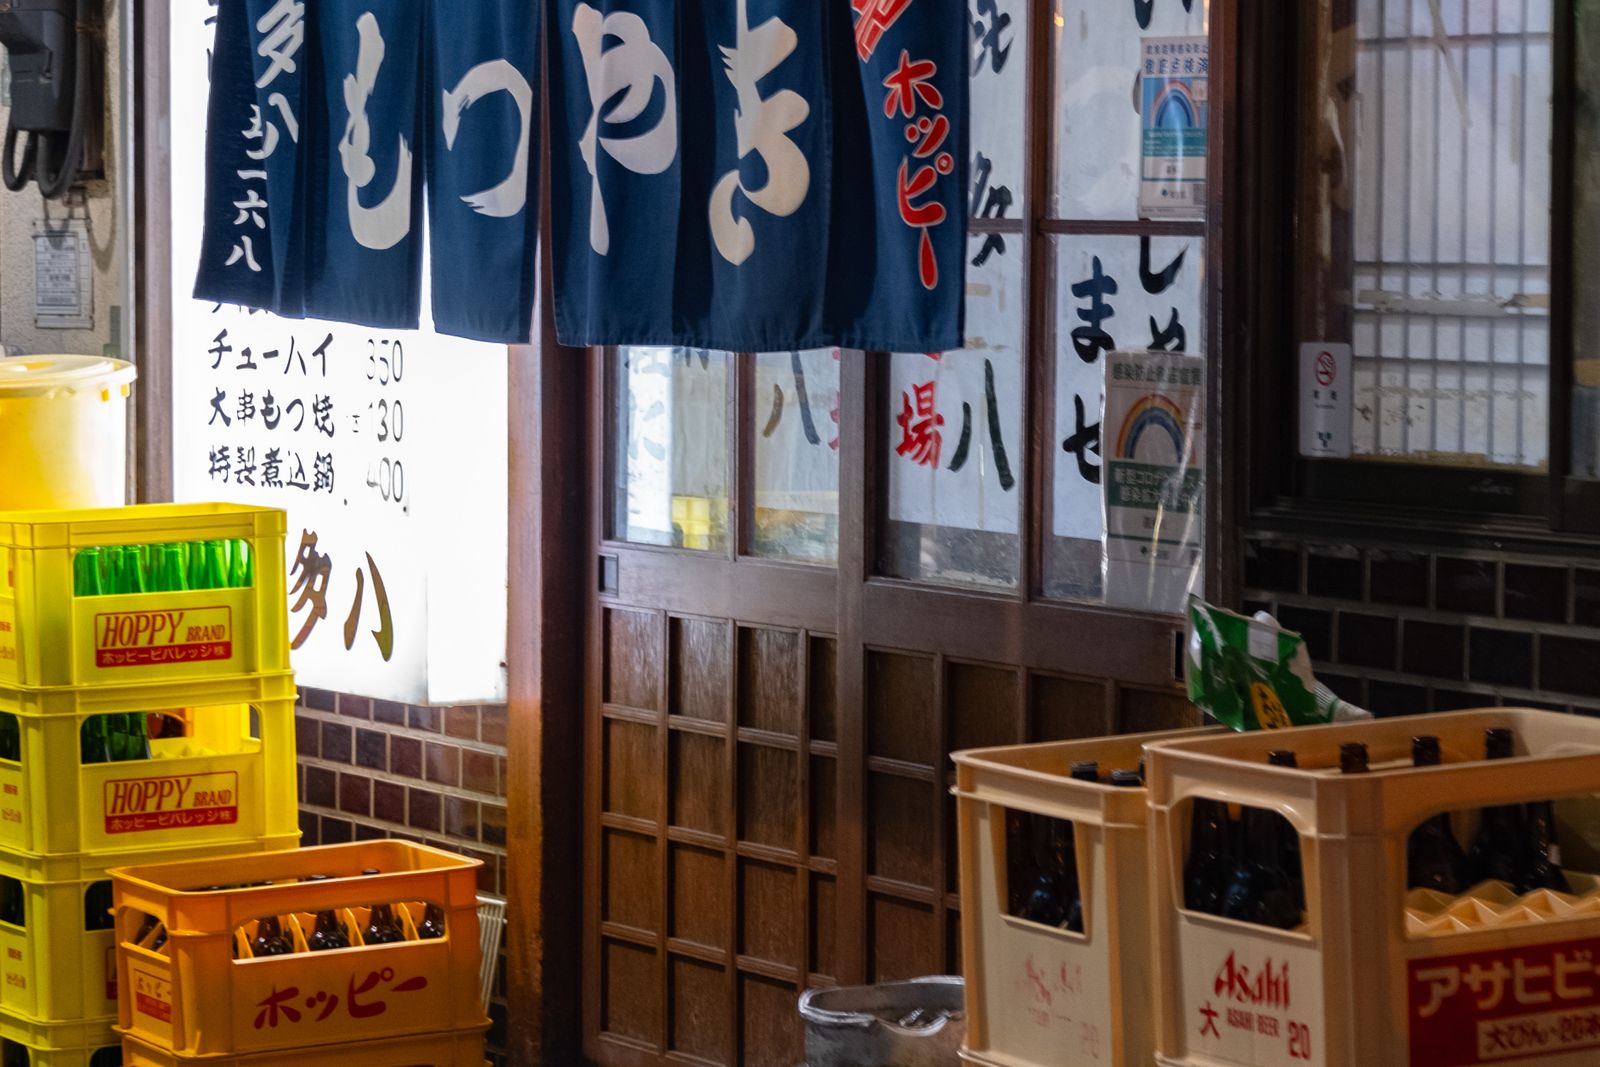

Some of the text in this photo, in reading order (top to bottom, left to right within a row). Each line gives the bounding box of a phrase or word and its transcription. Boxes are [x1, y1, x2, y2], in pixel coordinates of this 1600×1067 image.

[882, 49, 954, 290] ホッピー
[207, 328, 403, 386] チューハイ 350
[207, 386, 335, 438] 大串もつ焼
[367, 398, 403, 442] 30
[207, 444, 335, 494] 特製煮込鍋
[102, 612, 226, 648] HOPPY BRAND
[110, 778, 232, 814] HOPPY BRAND
[254, 966, 428, 1030] ホッピー
[1214, 949, 1291, 1011] Asahi
[1416, 950, 1600, 1017] アサヒビ
[1199, 1001, 1221, 1039] 大
[1287, 1020, 1311, 1060] 20
